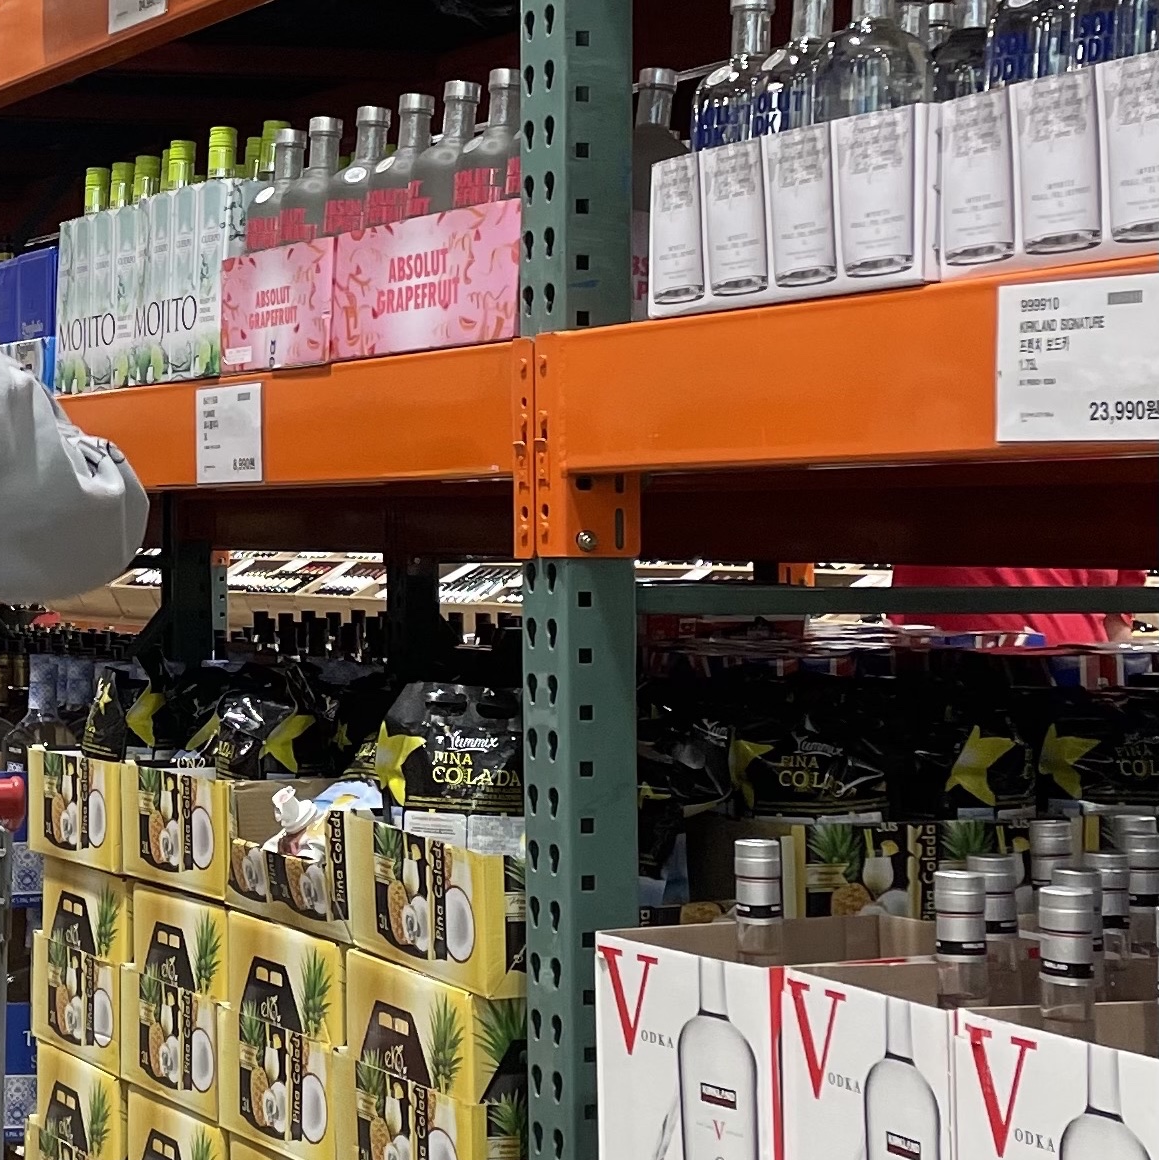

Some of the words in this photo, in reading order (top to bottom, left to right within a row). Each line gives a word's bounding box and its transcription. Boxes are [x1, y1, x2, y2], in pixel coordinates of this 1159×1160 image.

[389, 248, 448, 283] ABSOLUT
[255, 286, 290, 309] ABSOLUT
[376, 277, 460, 316] GRAPEFRUIT
[58, 313, 116, 356] MOJITO
[134, 295, 197, 343] MOJITO
[249, 306, 297, 330] GRAPEFRUIT
[1060, 315, 1105, 331] SIGNATURE
[432, 766, 521, 786] COLADA
[333, 870, 346, 903] Pina
[435, 905, 444, 941] Pina
[292, 1090, 300, 1124] Pina
[416, 1085, 426, 1140] Colad
